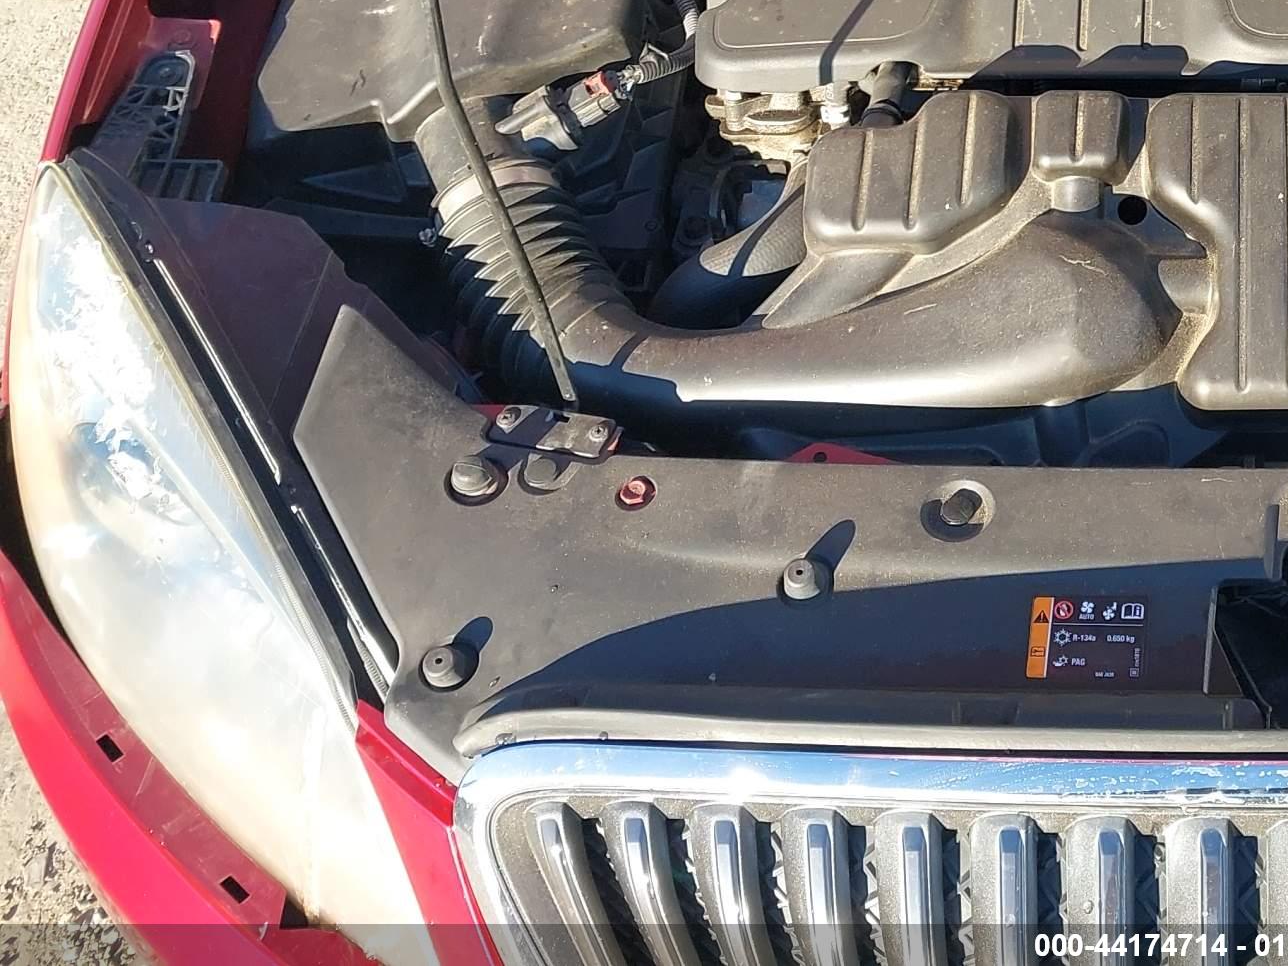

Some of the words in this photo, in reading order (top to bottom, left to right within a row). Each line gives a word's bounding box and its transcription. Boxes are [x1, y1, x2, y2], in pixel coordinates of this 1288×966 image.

[1073, 634, 1096, 642] R-134a
[1126, 635, 1135, 643] kg
[1072, 658, 1085, 666] PAG
